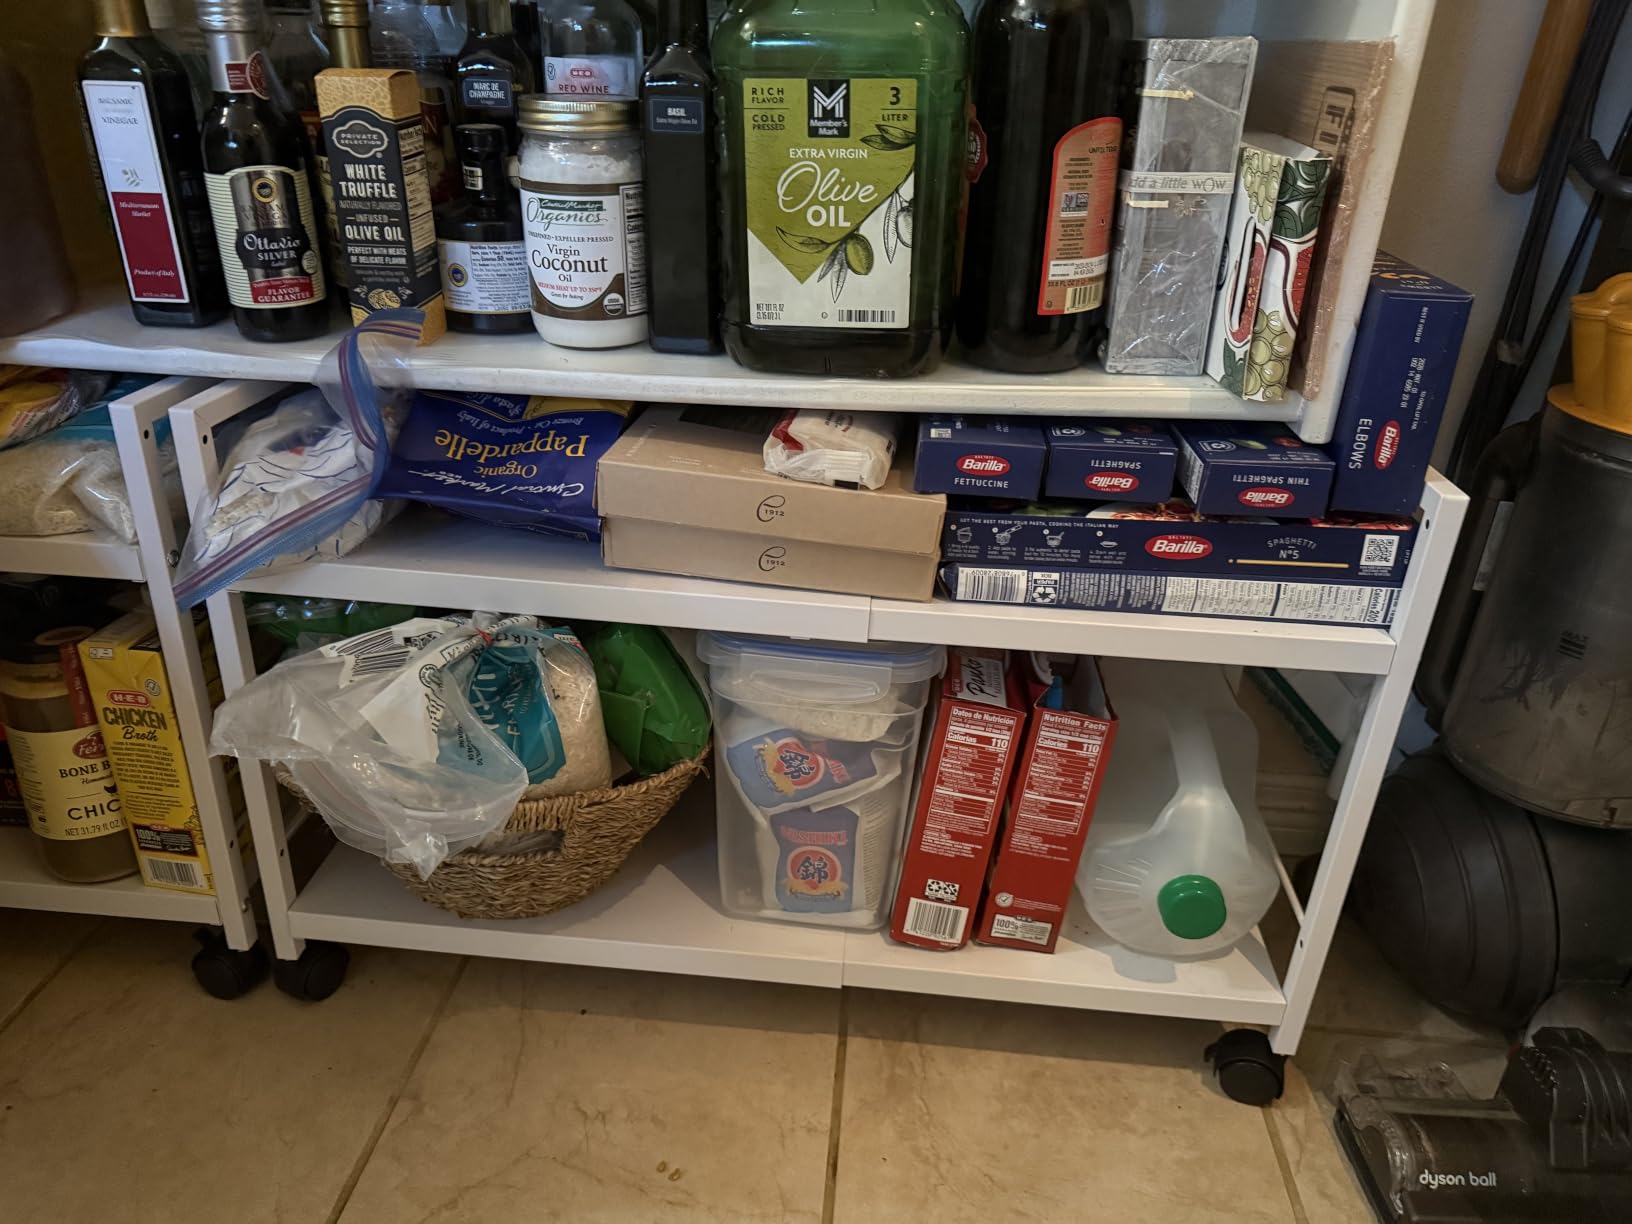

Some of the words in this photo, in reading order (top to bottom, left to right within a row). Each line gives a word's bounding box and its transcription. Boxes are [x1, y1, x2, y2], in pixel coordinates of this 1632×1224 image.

[559, 84, 577, 93] RED
[581, 84, 609, 95] WINE
[751, 87, 785, 97] RICH
[889, 86, 902, 105] 3
[752, 114, 786, 123] COLD
[809, 119, 848, 128] Member's
[881, 113, 909, 122] LITER
[752, 122, 786, 131] PRESSED
[818, 127, 839, 136] Mark
[789, 148, 825, 159] EXTRA
[828, 148, 868, 159] VIRGIN
[344, 164, 387, 181] WHITE
[777, 161, 878, 213] Olive
[1160, 175, 1188, 188] little
[339, 182, 398, 199] TRUFFLE
[526, 197, 608, 231] Organics
[806, 206, 851, 227] OIL
[345, 225, 381, 241] OLIVE
[384, 226, 406, 242] OIL
[257, 250, 297, 261] SILVER
[547, 243, 580, 258] Virgin
[531, 249, 609, 273] Coconut
[558, 273, 572, 282] Oil
[434, 429, 590, 463] Pappardelle
[1349, 418, 1373, 469] ELBOWS
[1378, 426, 1397, 464] Barilla
[474, 461, 537, 479] Organic
[963, 459, 1006, 471] Barilla
[1091, 459, 1141, 469] SPAGHETTI
[954, 477, 1009, 489] FETTUCCINE
[1092, 476, 1133, 488] Barilla
[1233, 474, 1284, 485] SPAGHETTI
[1287, 477, 1310, 486] THIN
[504, 482, 585, 498] Central
[1246, 491, 1289, 504] Barilla
[1152, 538, 1207, 555] Barilla
[1267, 537, 1318, 549] SPAGHETTI
[1371, 609, 1379, 623] 200
[103, 706, 167, 730] CHICKEN
[952, 708, 974, 719] Datos
[974, 712, 984, 720] de
[983, 713, 1015, 725] Nutrición
[1043, 713, 1082, 727] Nutrition
[1083, 720, 1107, 731] Facts
[122, 725, 159, 742] Broth
[948, 732, 977, 744] Calorias
[991, 738, 1008, 748] 110
[1038, 737, 1068, 749] Calories
[1082, 743, 1100, 754] 110
[59, 766, 99, 778] BONE
[65, 828, 81, 836] NET
[796, 855, 829, 884] 錦
[995, 918, 1018, 930] 100%
[1419, 1170, 1466, 1189] dyson
[1469, 1172, 1497, 1187] ball
